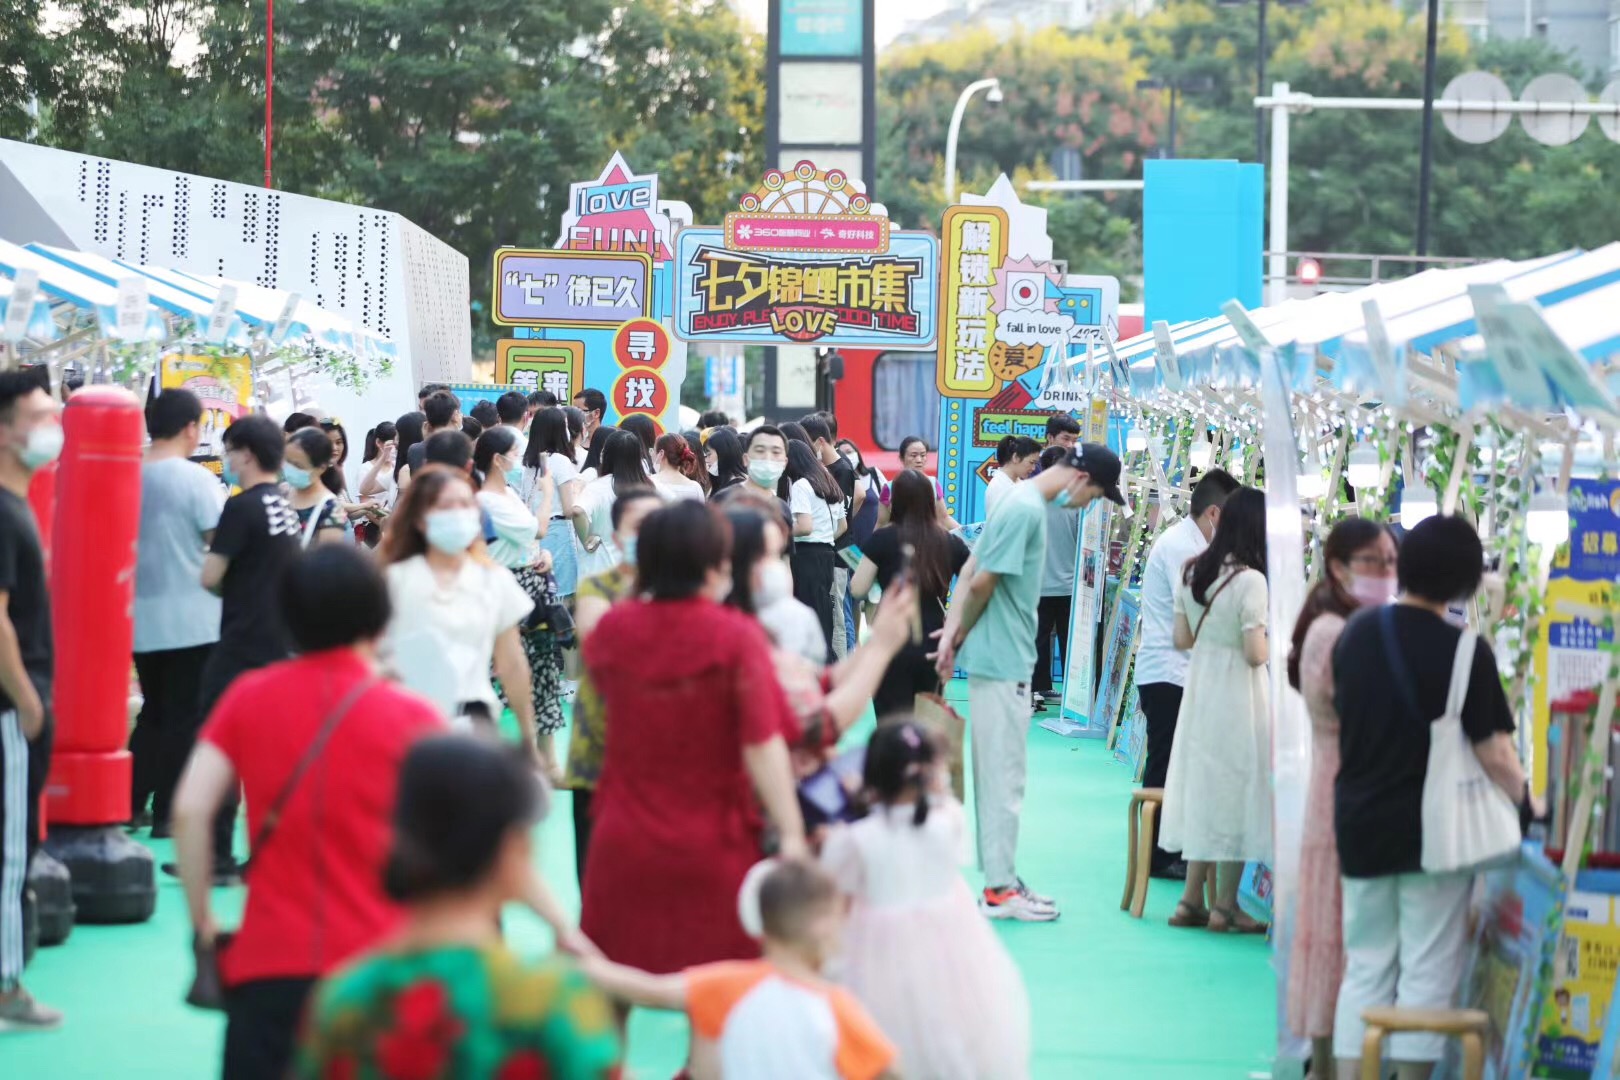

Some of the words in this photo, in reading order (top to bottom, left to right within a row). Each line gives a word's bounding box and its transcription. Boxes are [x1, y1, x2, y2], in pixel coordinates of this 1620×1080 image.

[579, 187, 651, 216] love
[700, 256, 916, 313] 七夕锦鲤市集
[694, 313, 738, 330] ENJOY
[743, 309, 771, 325] PLE
[834, 307, 872, 326] OOD
[876, 311, 916, 332] TIME
[769, 309, 839, 336] LOVE
[1006, 322, 1025, 333] fall
[1026, 322, 1036, 333] in
[1038, 322, 1062, 334] love
[981, 418, 1011, 434] feel
[1012, 420, 1048, 439] happ
